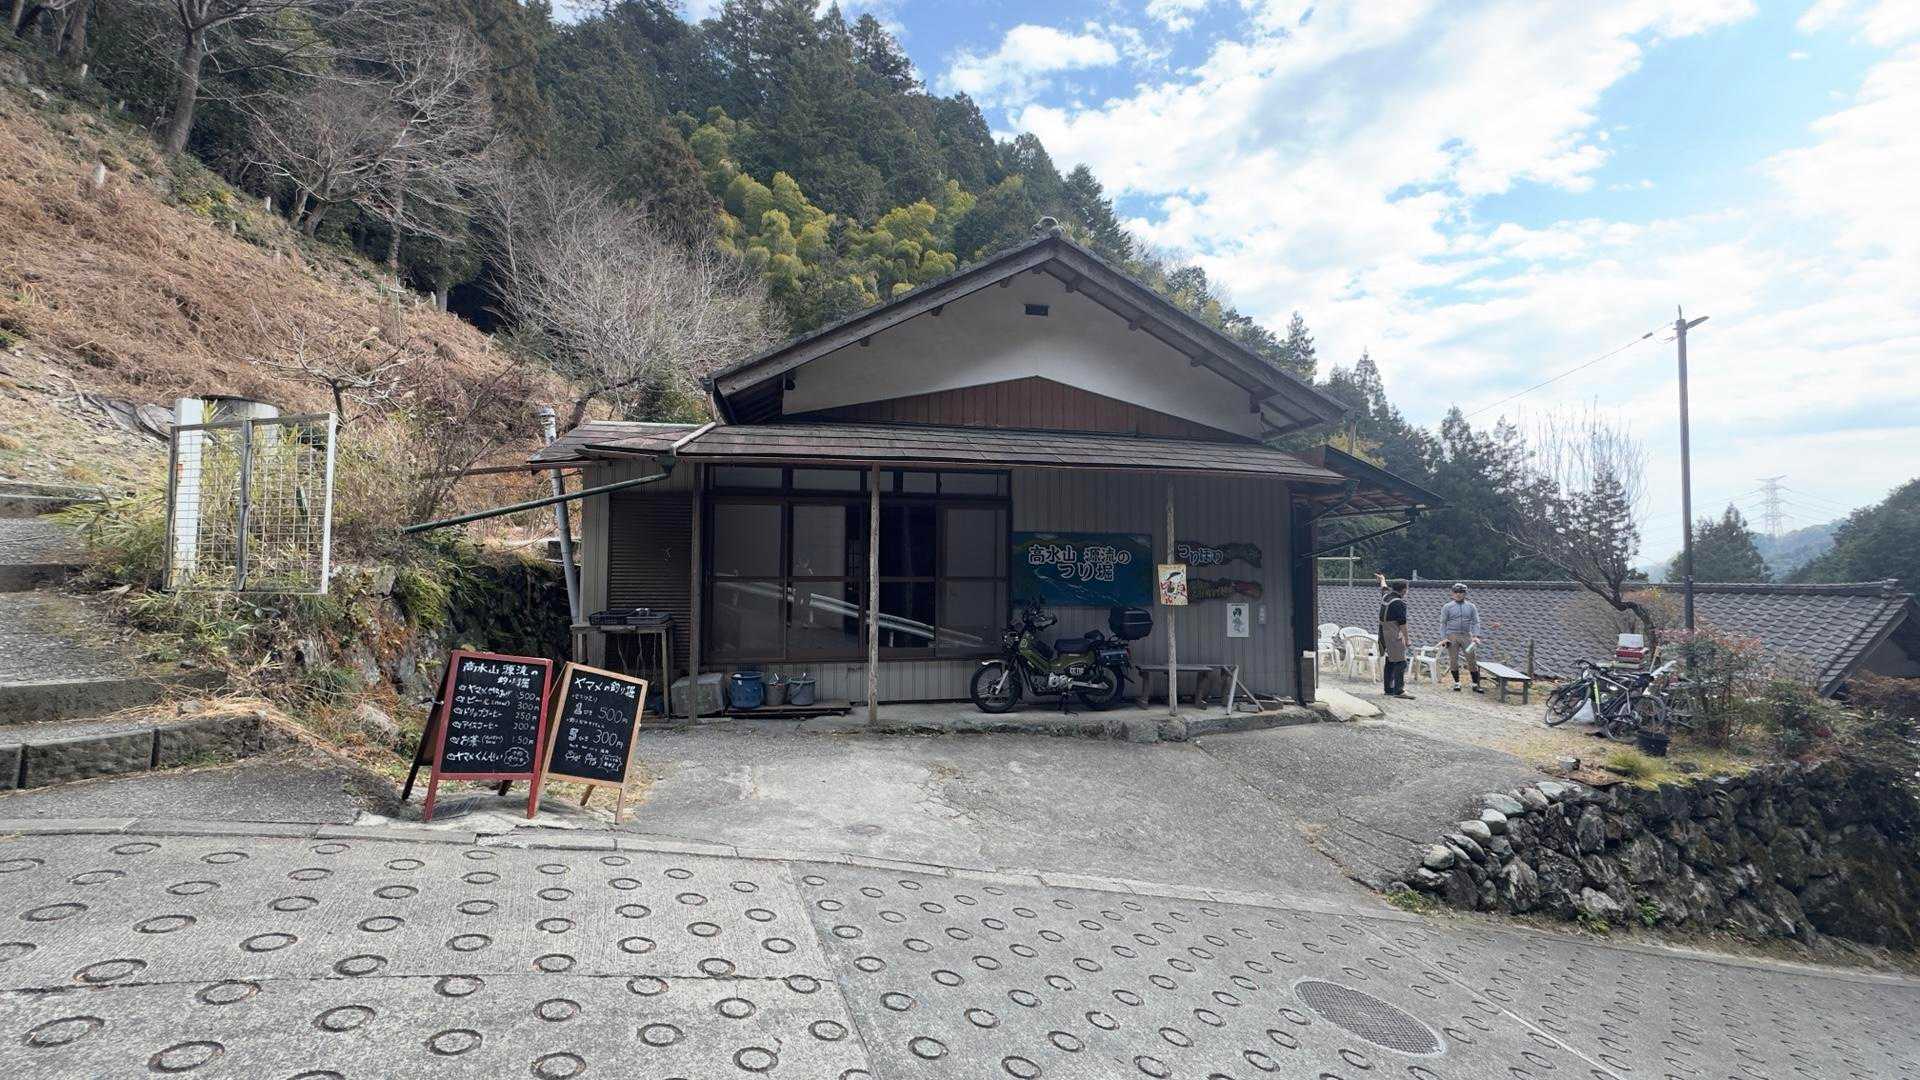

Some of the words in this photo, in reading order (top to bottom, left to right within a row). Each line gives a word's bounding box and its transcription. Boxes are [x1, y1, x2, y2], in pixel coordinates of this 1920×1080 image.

[1028, 544, 1077, 565] 高水山
[1084, 545, 1131, 565] 源流の
[1057, 562, 1114, 582] つり堀
